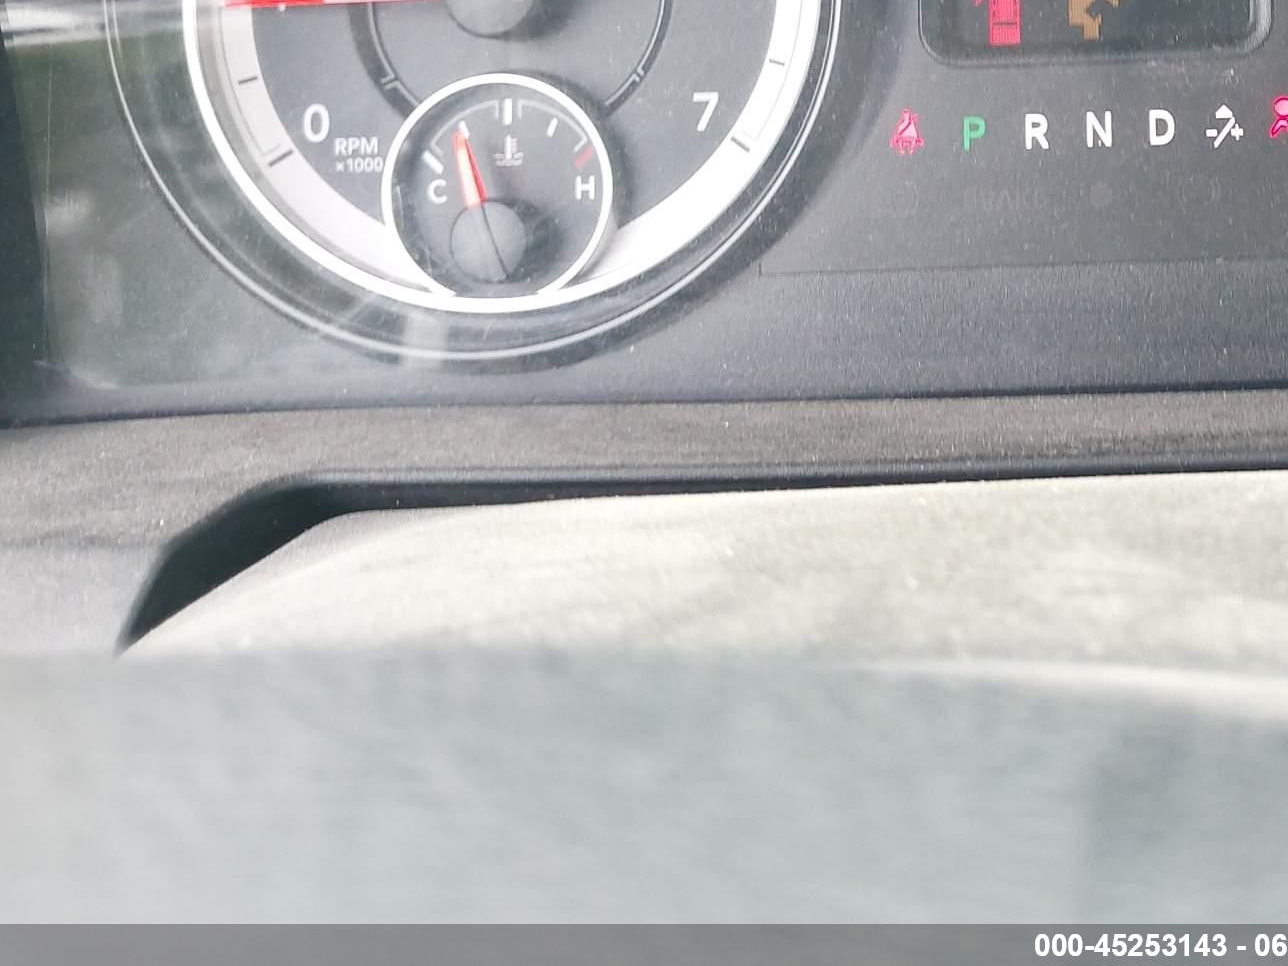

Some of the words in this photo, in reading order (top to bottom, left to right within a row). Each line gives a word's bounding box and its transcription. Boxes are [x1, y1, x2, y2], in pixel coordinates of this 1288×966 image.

[303, 103, 331, 144] 0
[691, 90, 720, 132] 7
[334, 137, 379, 156] RPM
[963, 116, 986, 151] P
[1025, 114, 1050, 151] R
[1086, 112, 1114, 148] N
[1148, 109, 1176, 146] D
[428, 180, 448, 206] C
[574, 175, 596, 202] H
